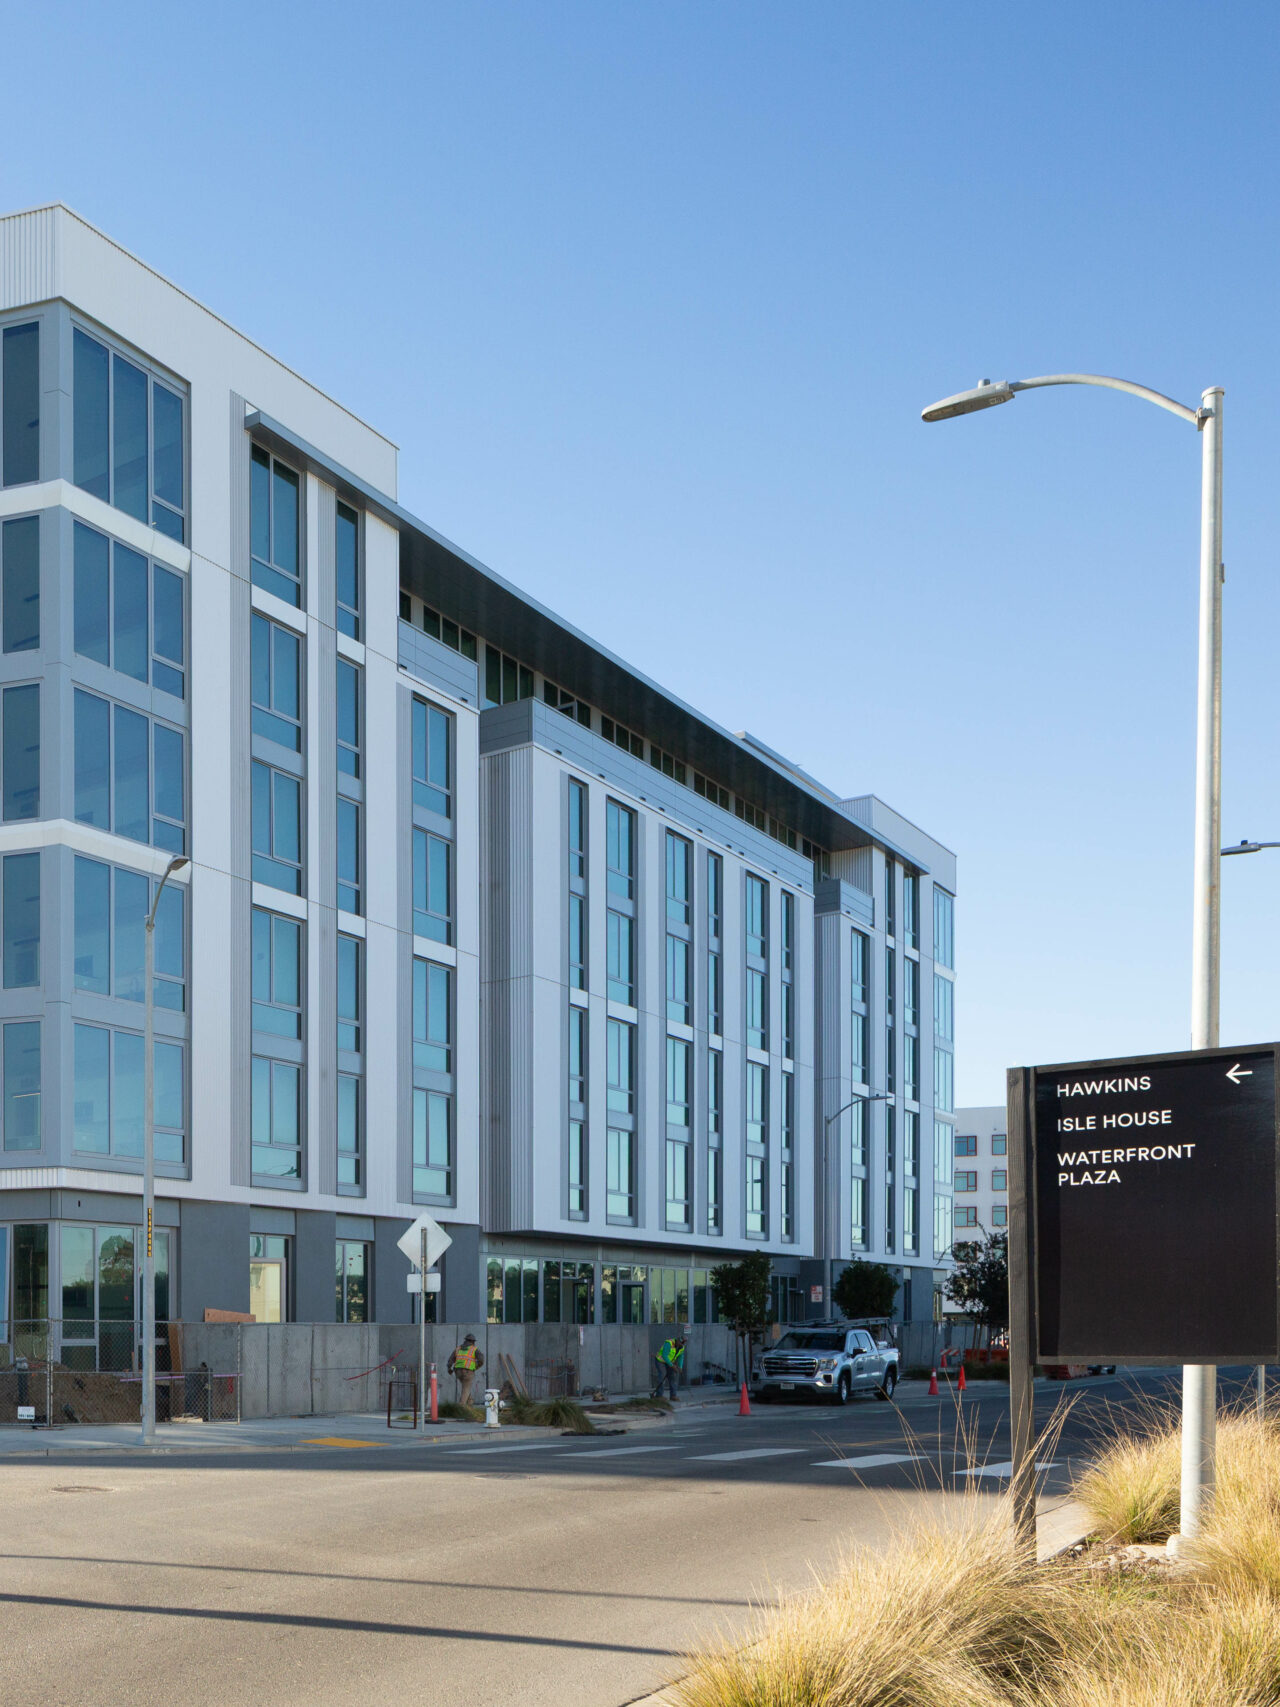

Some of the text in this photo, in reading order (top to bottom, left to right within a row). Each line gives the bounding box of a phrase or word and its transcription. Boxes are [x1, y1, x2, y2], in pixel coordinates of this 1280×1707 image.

[1057, 1076, 1152, 1098] HAWKINS
[1057, 1109, 1172, 1132] ISLE HOUSE
[1057, 1143, 1196, 1167] WATERFRONT
[1058, 1170, 1121, 1187] PLAZA
